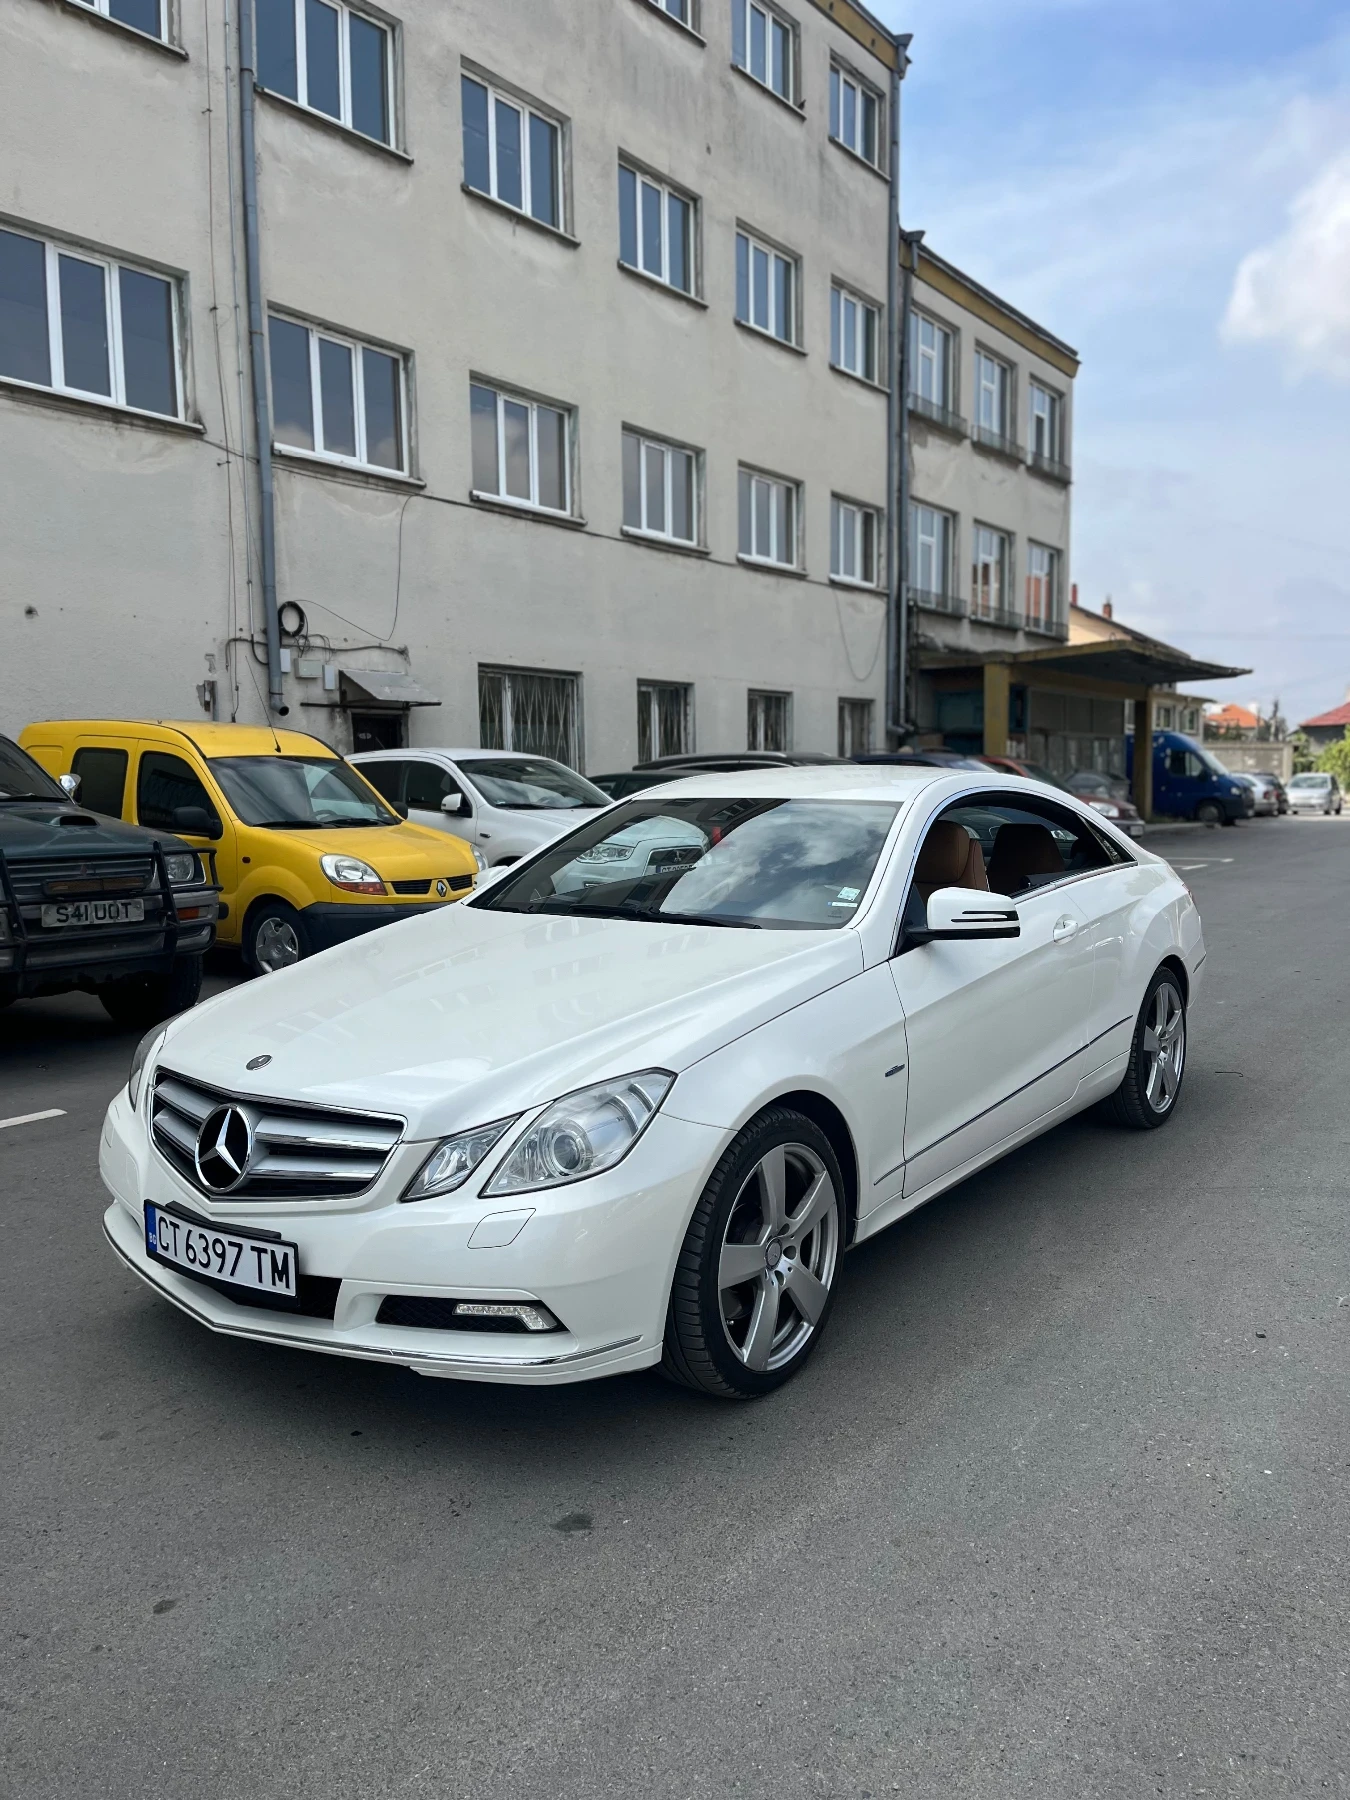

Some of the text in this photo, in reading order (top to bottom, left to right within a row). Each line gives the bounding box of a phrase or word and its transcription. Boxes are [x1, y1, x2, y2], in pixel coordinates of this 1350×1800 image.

[149, 1232, 157, 1245] BG
[158, 1216, 291, 1290] CT 6397 TM
